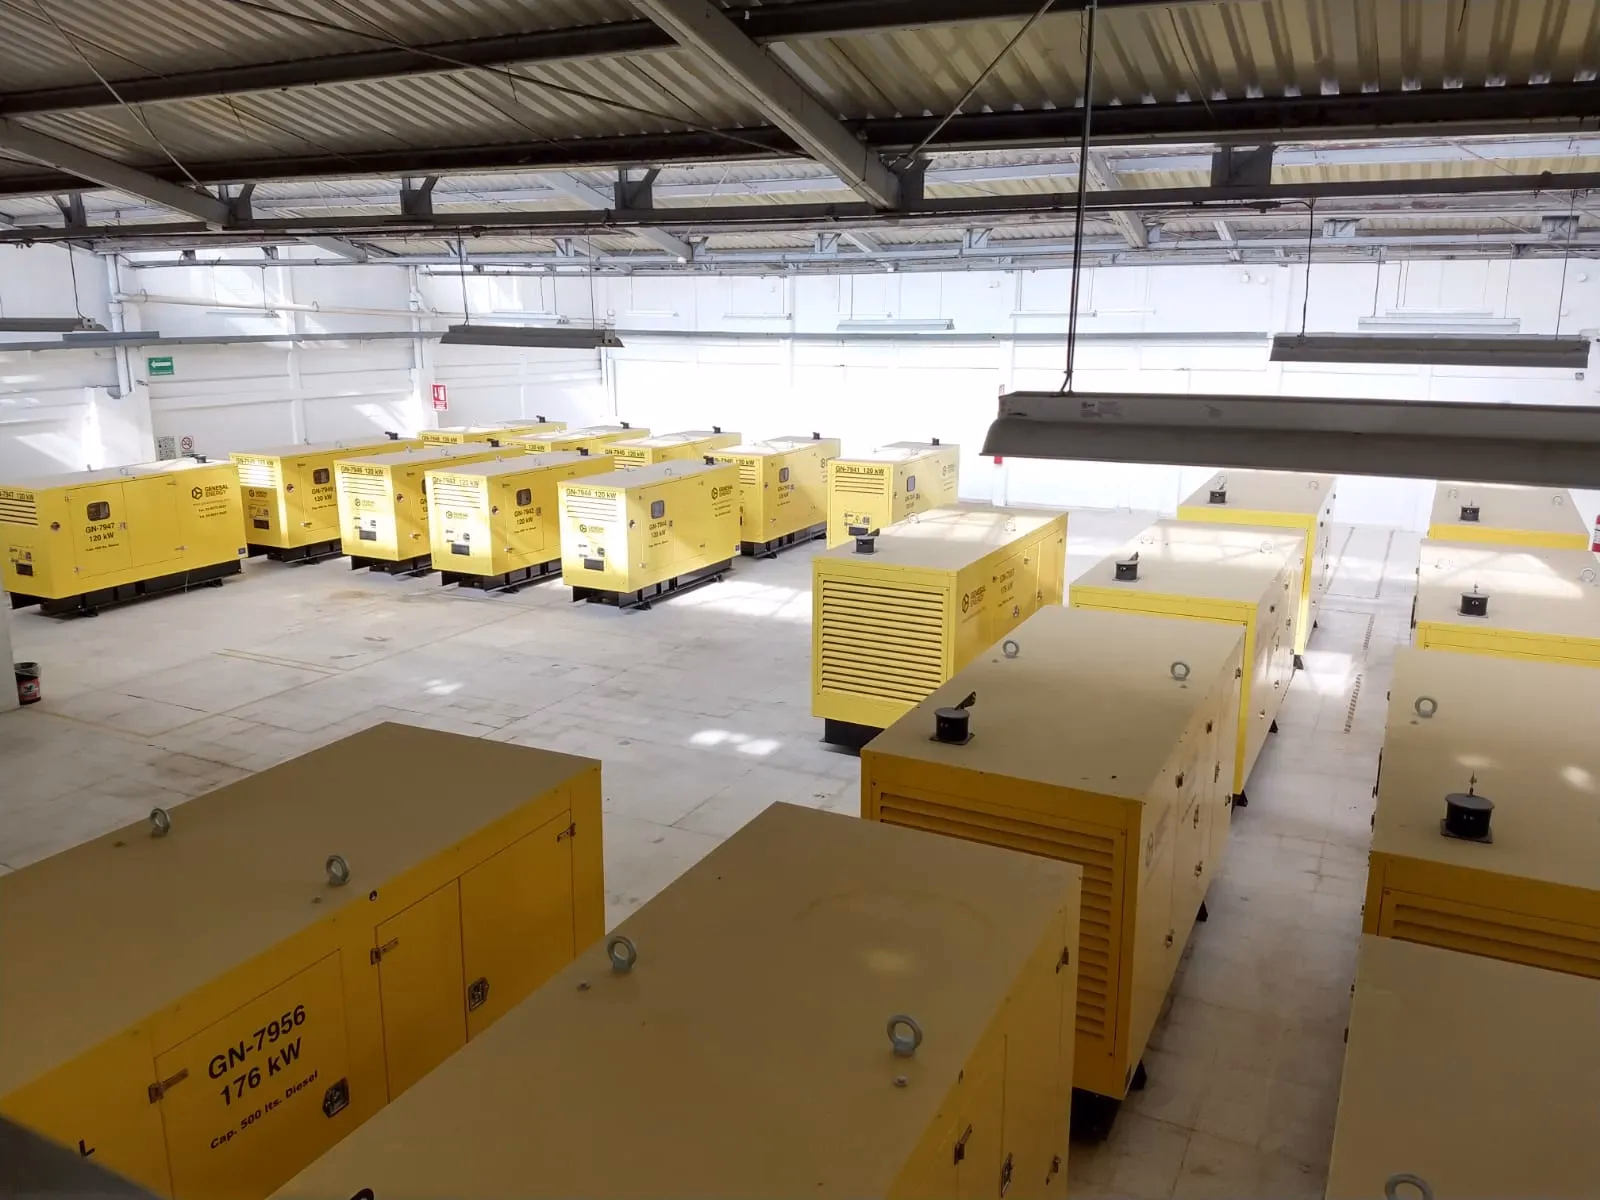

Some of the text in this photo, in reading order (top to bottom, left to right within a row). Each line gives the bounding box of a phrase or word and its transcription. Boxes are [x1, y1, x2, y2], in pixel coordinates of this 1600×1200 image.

[595, 489, 605, 498] 120
[606, 491, 617, 499] kW
[85, 522, 115, 534] GN-7947
[89, 532, 114, 543] 120 kW
[208, 1004, 307, 1080] GN-7956
[220, 1036, 302, 1107] 176 kW
[210, 1129, 238, 1150] Cap.
[240, 1109, 262, 1130] 500
[284, 1069, 319, 1100] Diesel
